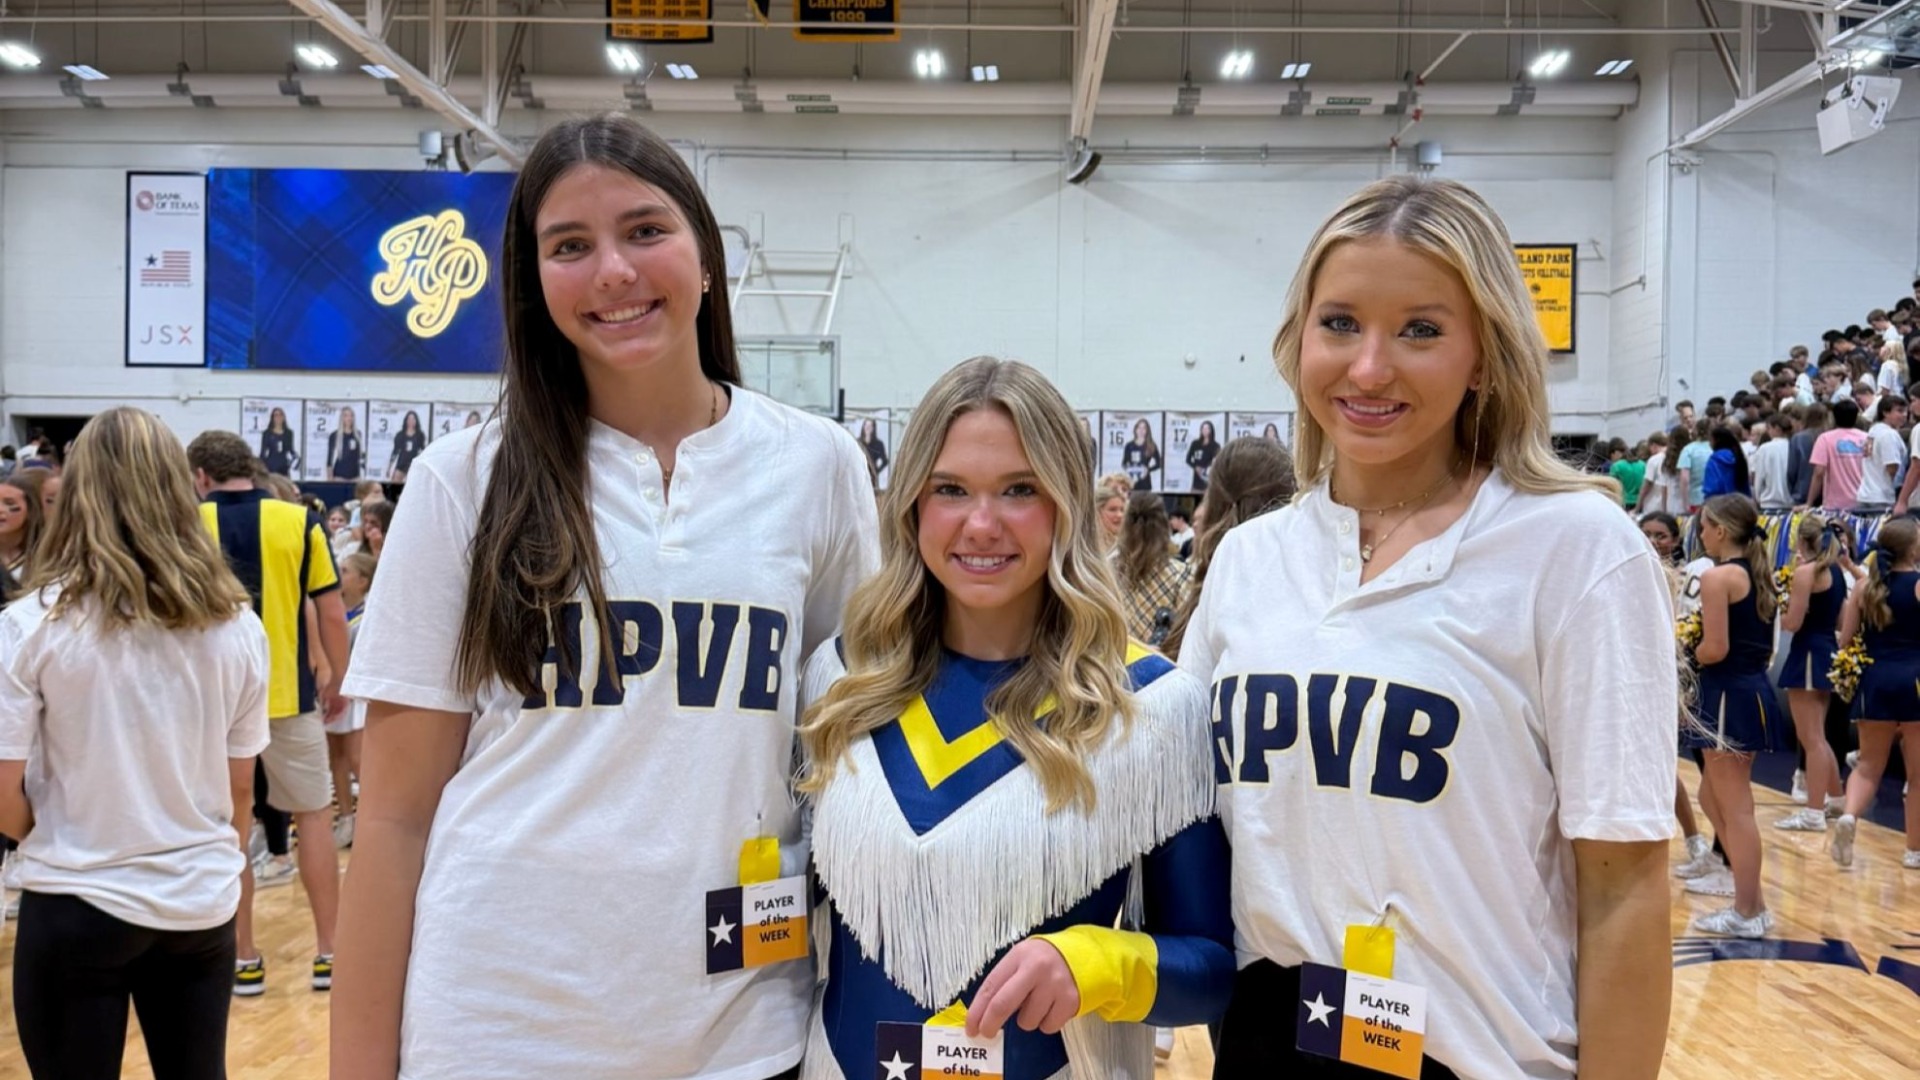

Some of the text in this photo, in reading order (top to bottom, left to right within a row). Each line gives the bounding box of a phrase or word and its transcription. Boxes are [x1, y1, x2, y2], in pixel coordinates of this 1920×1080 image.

[156, 192, 181, 200] BANK
[156, 201, 199, 210] OF TEXAS
[1517, 253, 1570, 264] LAND PARK
[140, 325, 192, 345] JSX
[252, 415, 259, 430] 1
[316, 417, 327, 432] 2
[379, 418, 388, 433] 3
[1109, 430, 1125, 446] 16
[1173, 428, 1188, 443] 17
[754, 895, 795, 912] PLAYER
[760, 913, 790, 927] of the
[760, 928, 791, 943] WEEK
[1360, 993, 1411, 1017] PLAYER
[1365, 1015, 1403, 1033] of the
[1363, 1030, 1402, 1052] WEEK
[937, 1045, 988, 1060] PLAYER
[943, 1063, 981, 1077] of the
